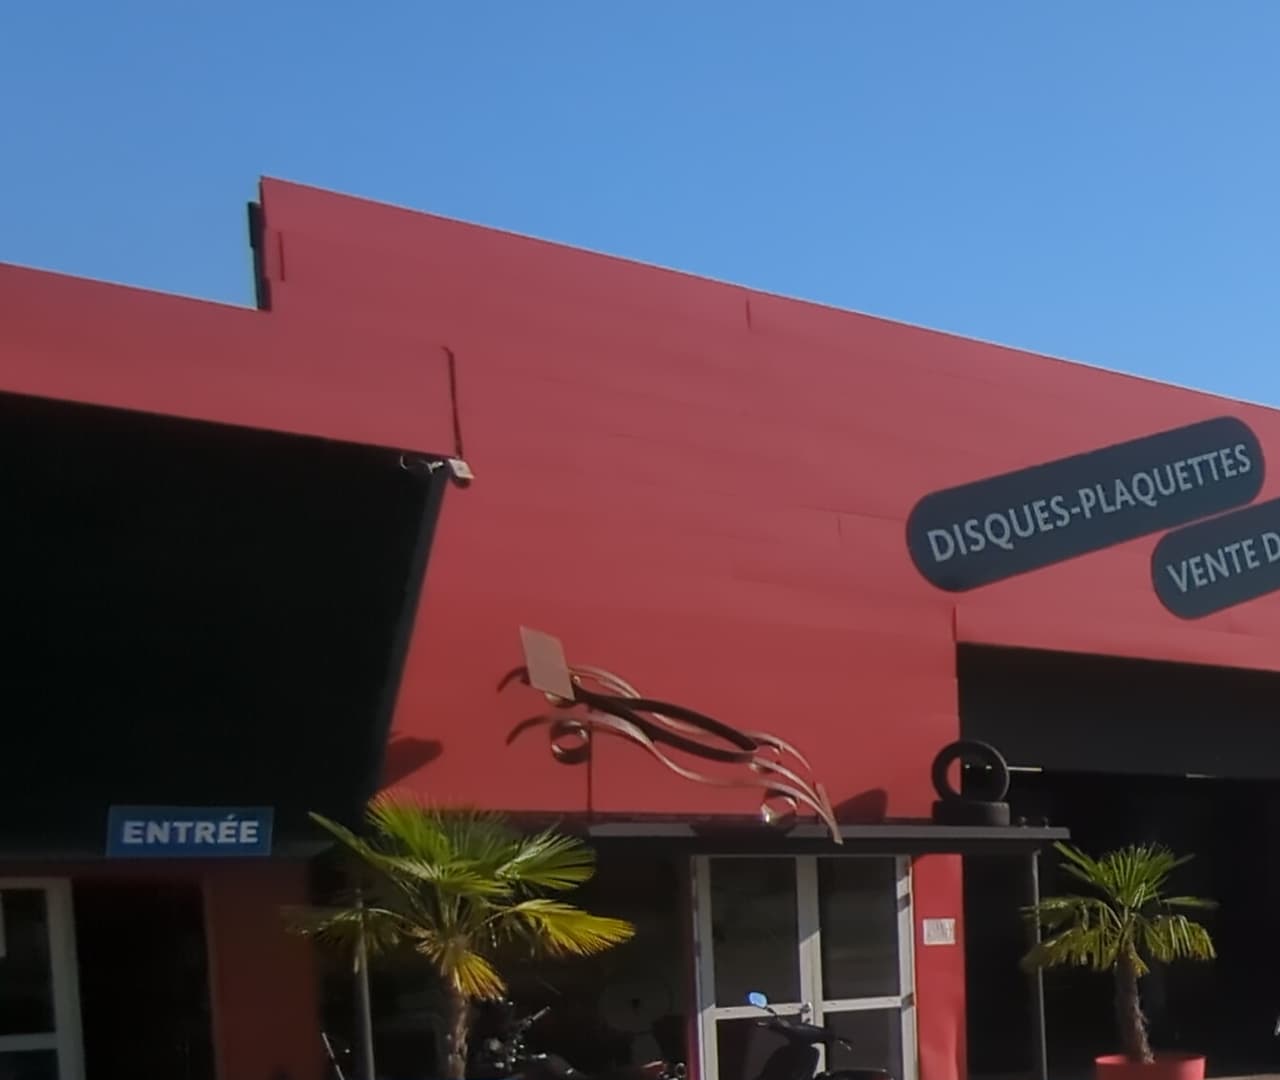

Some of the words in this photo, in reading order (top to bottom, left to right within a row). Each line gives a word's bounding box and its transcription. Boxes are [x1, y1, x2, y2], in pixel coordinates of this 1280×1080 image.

[927, 444, 1251, 562] DISQUES-PLAQUETTES
[1166, 539, 1260, 593] VENTE
[122, 813, 259, 844] ENTRÉE
